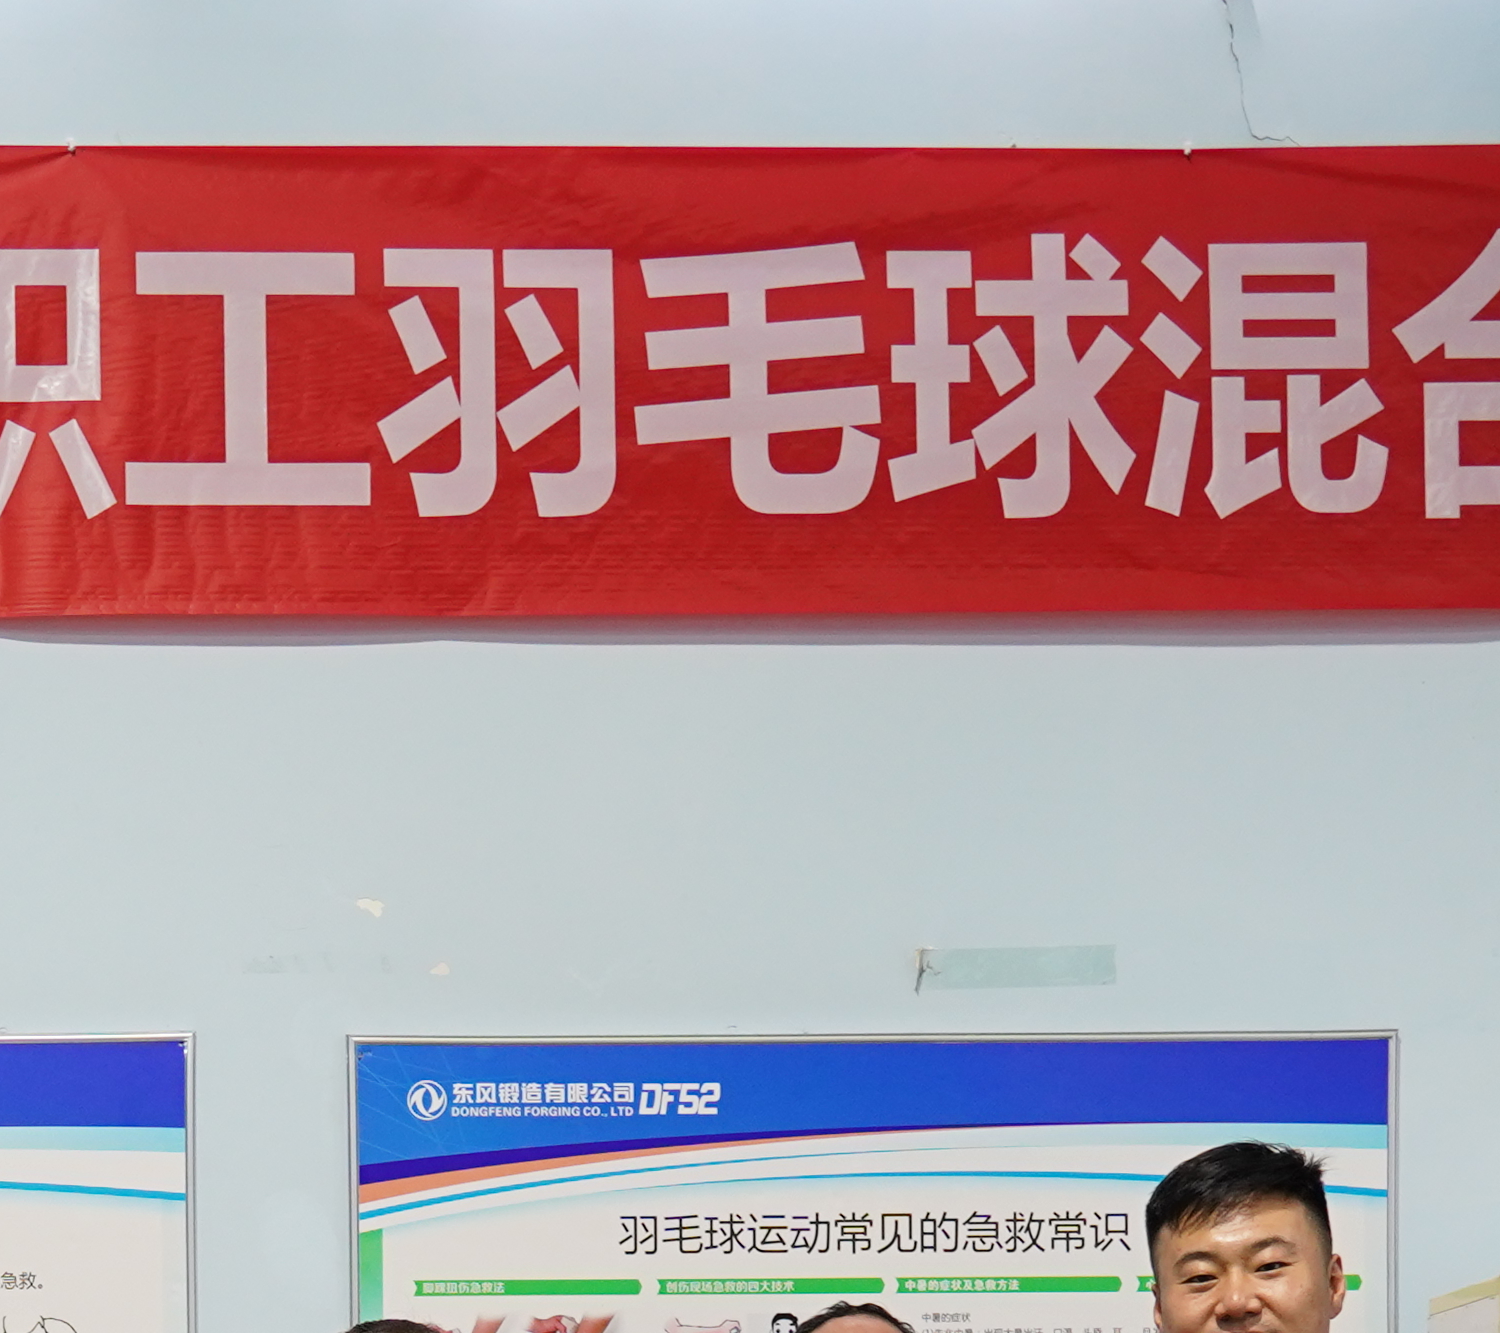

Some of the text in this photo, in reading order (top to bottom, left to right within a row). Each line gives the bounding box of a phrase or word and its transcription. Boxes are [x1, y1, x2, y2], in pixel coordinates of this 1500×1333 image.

[452, 1082, 722, 1116] 东风锻造有限公司 DF52
[451, 1106, 522, 1118] DONGFENG
[524, 1106, 581, 1118] FORGING
[610, 1105, 635, 1117] LTD
[618, 1211, 1132, 1255] 羽毛球运动常见的急救常识
[666, 1279, 795, 1294] 创伤现场急救的四大技术
[904, 1278, 1020, 1292] 中暑的症状及急救方法
[921, 1312, 972, 1323] 中暑的症状
